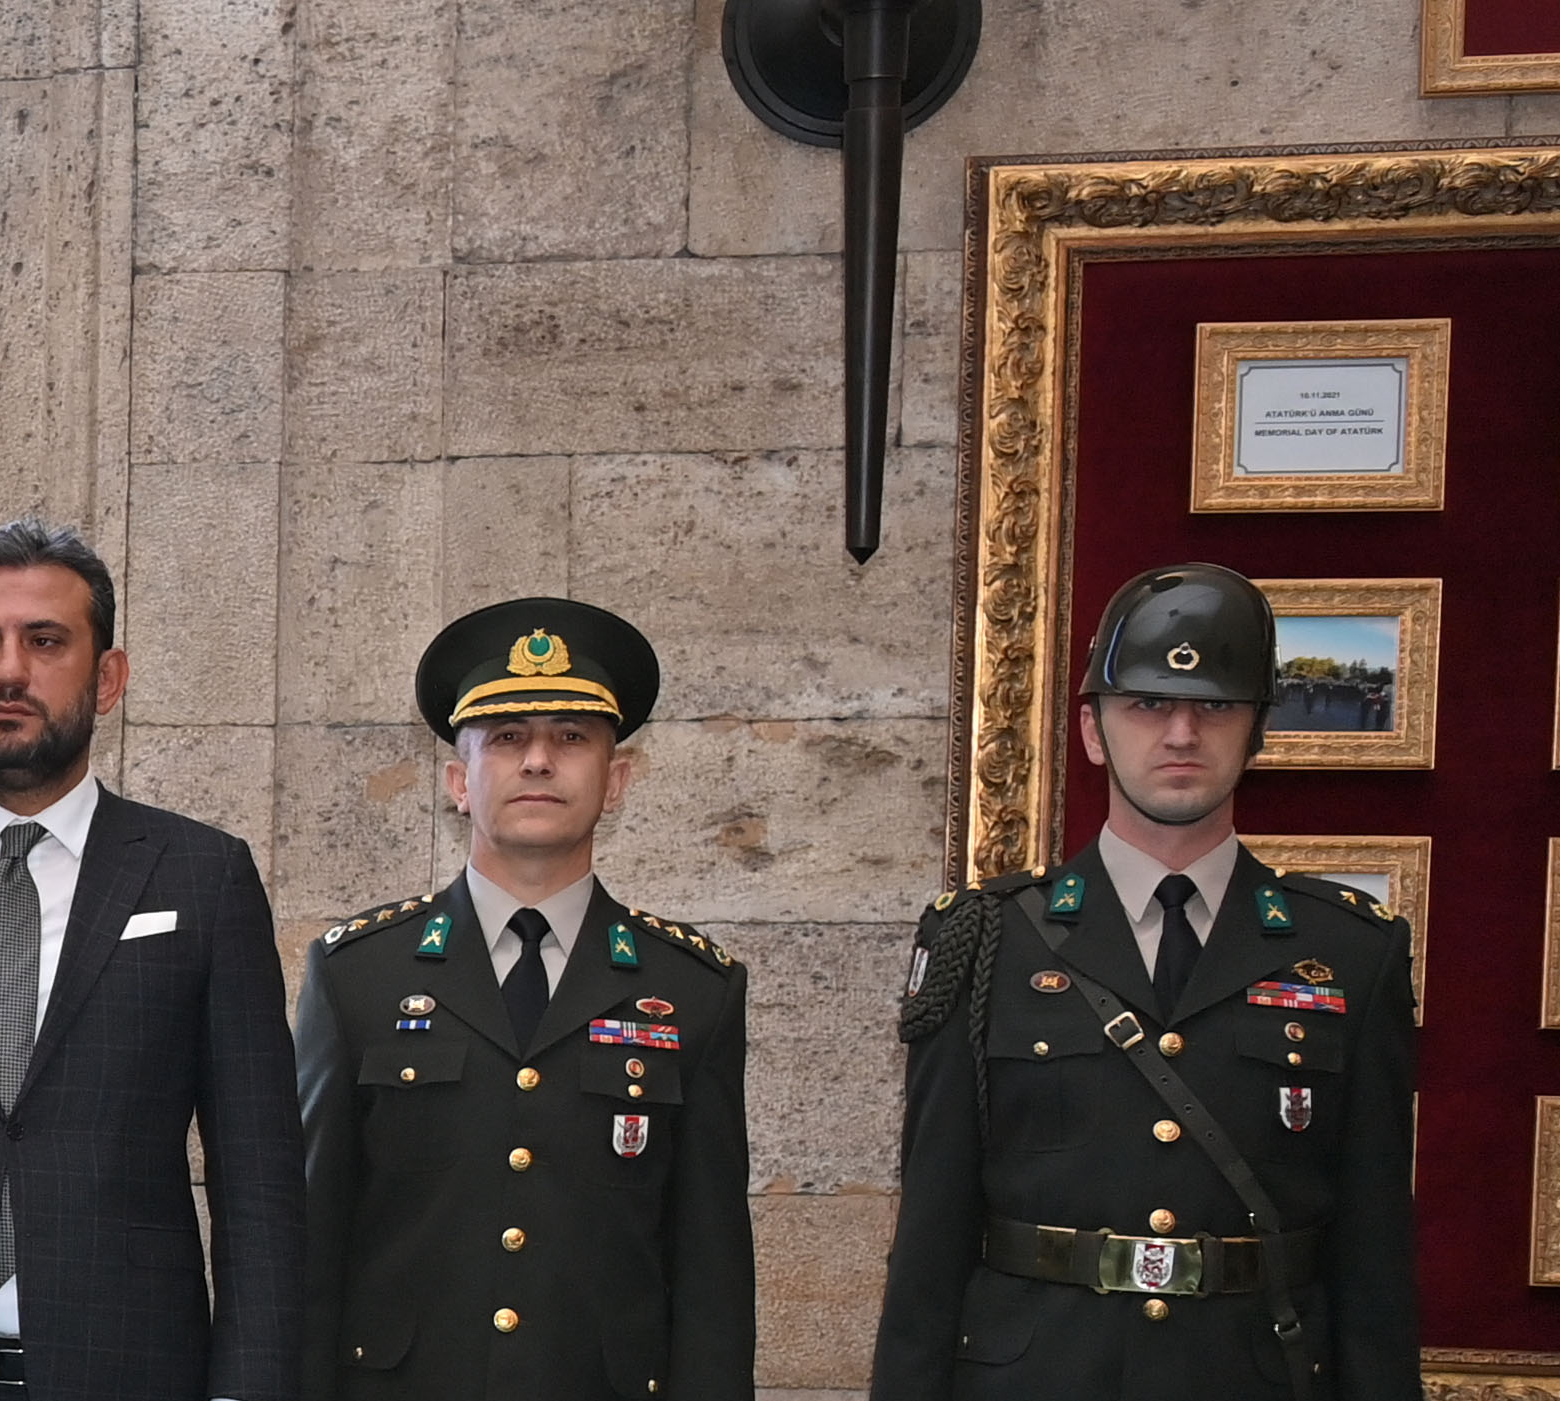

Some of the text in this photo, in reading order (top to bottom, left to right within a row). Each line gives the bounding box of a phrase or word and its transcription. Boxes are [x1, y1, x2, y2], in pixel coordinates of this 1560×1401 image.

[1319, 409, 1346, 417] ANMA
[1348, 408, 1374, 417] GÜNÜ
[1254, 427, 1384, 437] MEMORIAL DAY OF ATATÜRK
